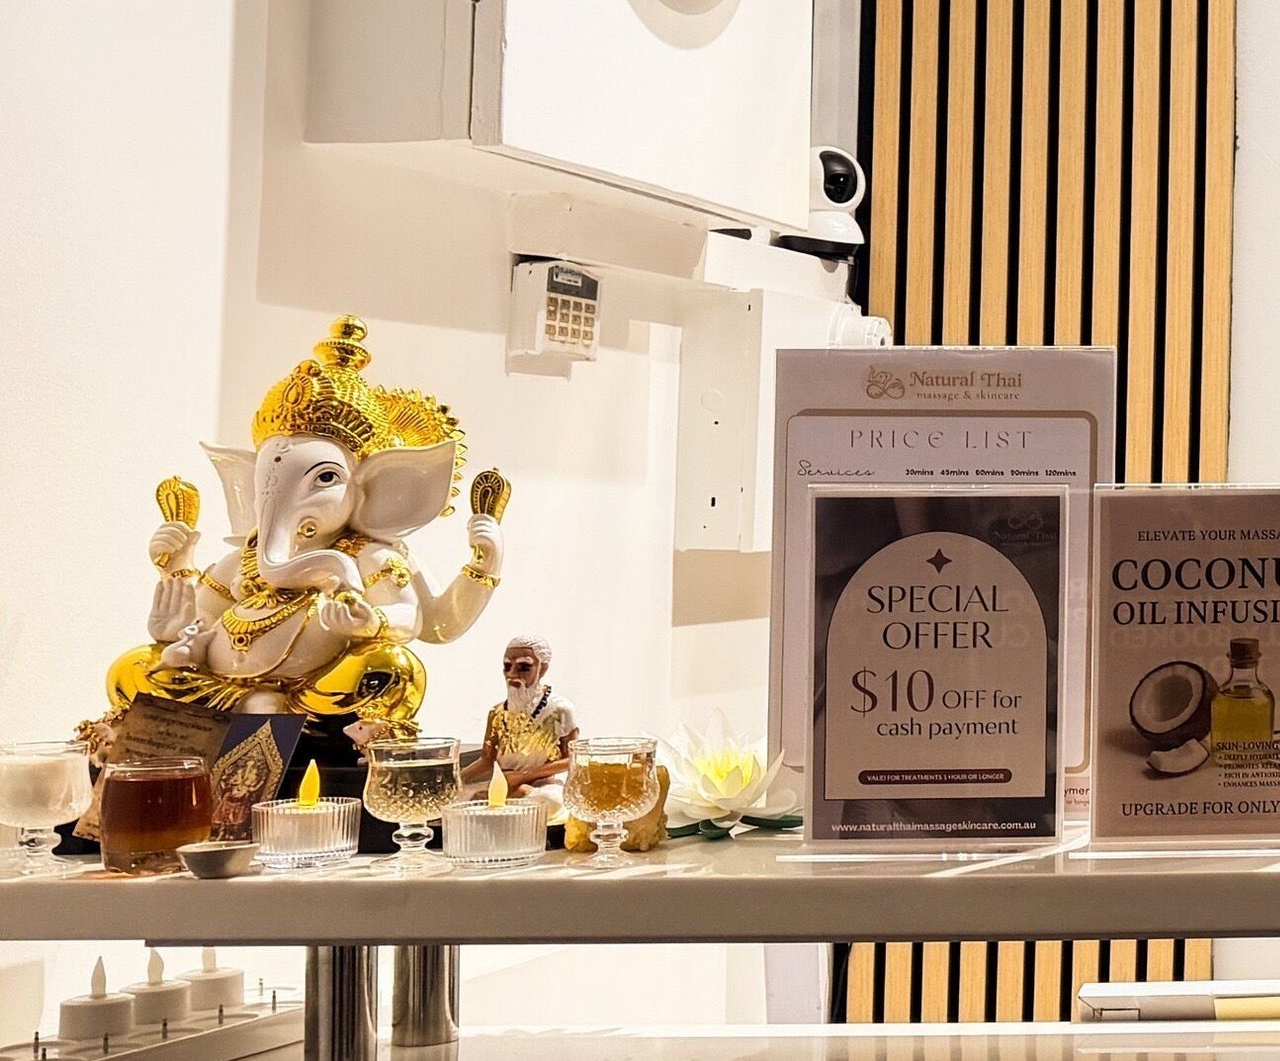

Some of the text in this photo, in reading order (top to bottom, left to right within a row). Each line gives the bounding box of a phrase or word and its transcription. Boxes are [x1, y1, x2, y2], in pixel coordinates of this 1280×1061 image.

[910, 371, 1022, 388] Natural Thai
[917, 390, 1020, 401] massage & skincare
[850, 429, 1032, 449] PRICE LIST
[797, 459, 876, 477] Services
[1138, 530, 1196, 542] ELEVATE
[1199, 529, 1236, 541] YOUR
[866, 584, 1009, 614] SPECIAL
[1112, 600, 1167, 626] OIL
[882, 621, 993, 650] OFFER
[850, 666, 1022, 718] $10 OFF for
[876, 717, 1019, 740] cash payment
[1216, 741, 1279, 751] SKIN-LOVING
[1122, 802, 1198, 816] UPGRADE
[1203, 801, 1234, 814] FOR
[1237, 800, 1280, 814] ONLY
[831, 820, 1037, 833] www.naturalthaimassageskincare.com.au
